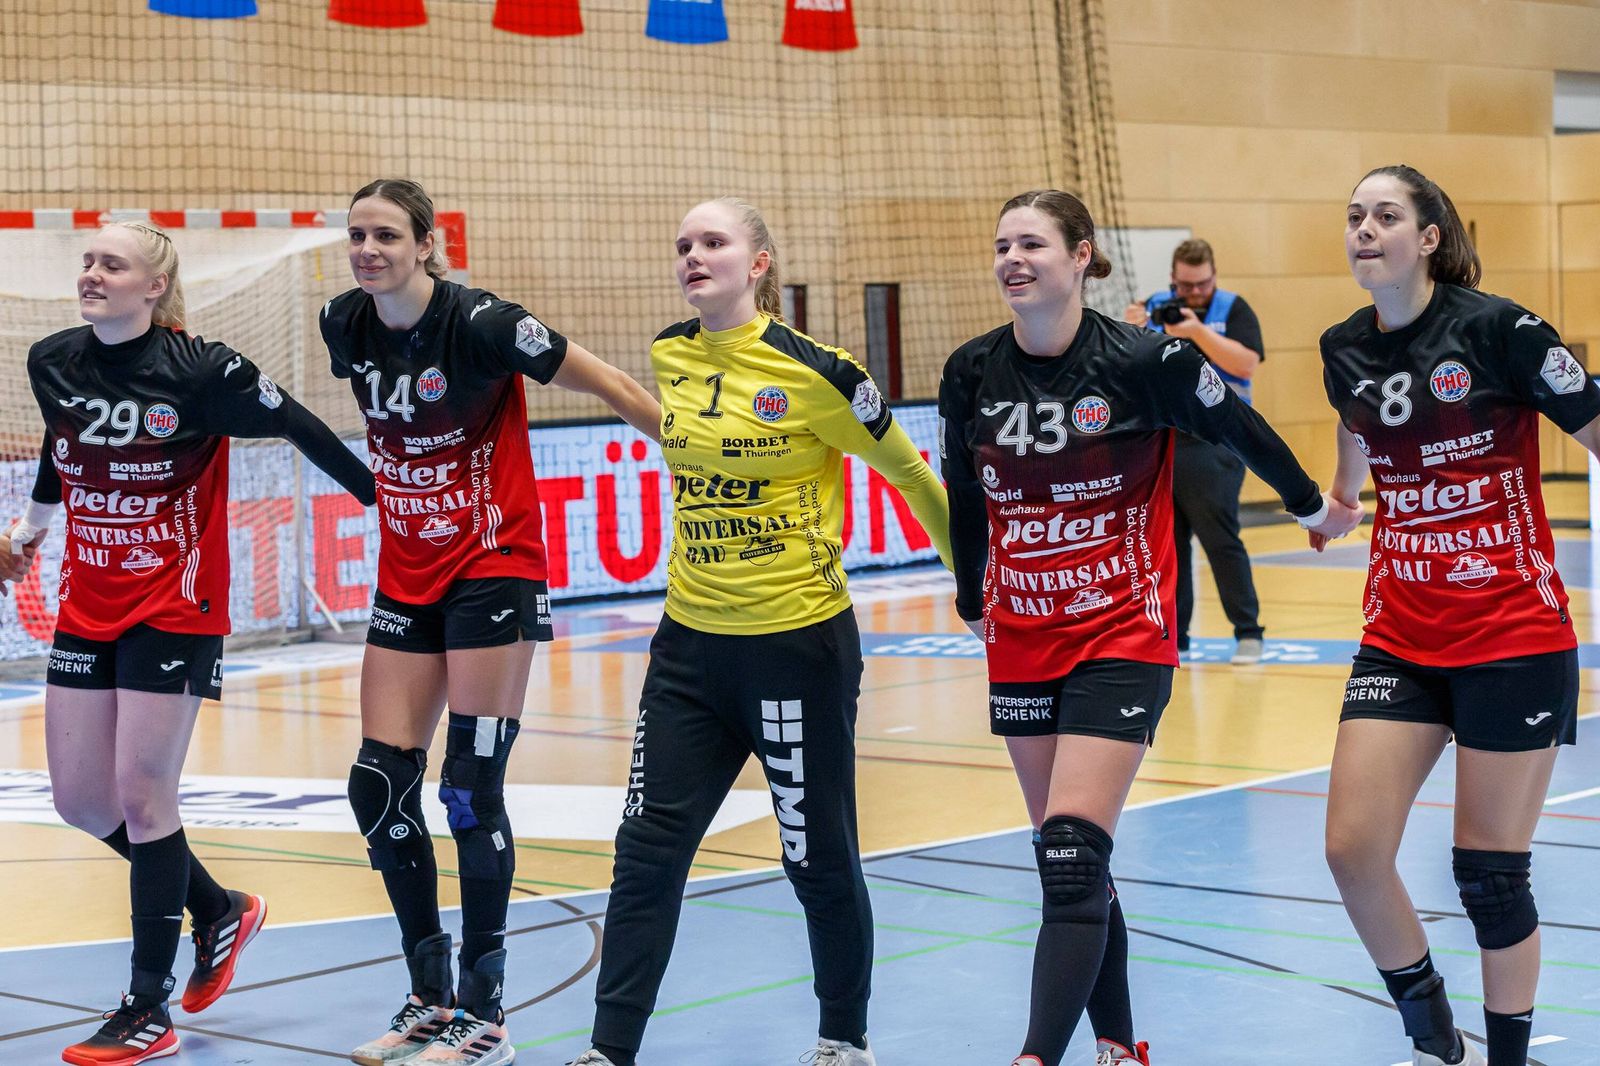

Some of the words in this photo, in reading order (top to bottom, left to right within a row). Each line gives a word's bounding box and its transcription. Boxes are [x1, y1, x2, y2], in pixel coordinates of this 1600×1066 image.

[419, 377, 445, 392] THC
[1433, 372, 1468, 393] THC
[366, 370, 415, 422] 14
[698, 372, 725, 419] 1
[757, 396, 786, 413] THC
[1379, 371, 1413, 427] 8
[79, 399, 139, 446] 29
[148, 413, 176, 429] THC
[1075, 406, 1108, 423] THC
[402, 428, 464, 447] BORBET
[996, 402, 1068, 456] 43
[661, 436, 688, 449] wald
[722, 435, 789, 448] BORBET
[745, 448, 791, 458] Thüringen
[1420, 429, 1494, 456] BORBET
[1447, 443, 1494, 462] Thüringen
[110, 460, 173, 473] BORBET
[130, 472, 174, 481] Thüringen
[674, 474, 770, 502] peter
[1050, 474, 1123, 494] BORBET
[1500, 470, 1517, 499] Bad
[69, 487, 168, 515] peter
[796, 484, 809, 508] Bad
[1515, 467, 1536, 544] Stadtwerke
[1000, 504, 1045, 516] Autohaus
[1000, 511, 1116, 550] peter
[1384, 523, 1511, 554] UNIVERSAL
[1507, 502, 1532, 582] Langensalza
[77, 543, 109, 567] BAU
[686, 545, 726, 564] BAU
[1000, 555, 1126, 592] UNIVERSAL
[1392, 558, 1431, 582] BAU
[1010, 594, 1054, 617] BAU
[995, 707, 1052, 721] SCHENK
[1046, 848, 1078, 858] SELECT
